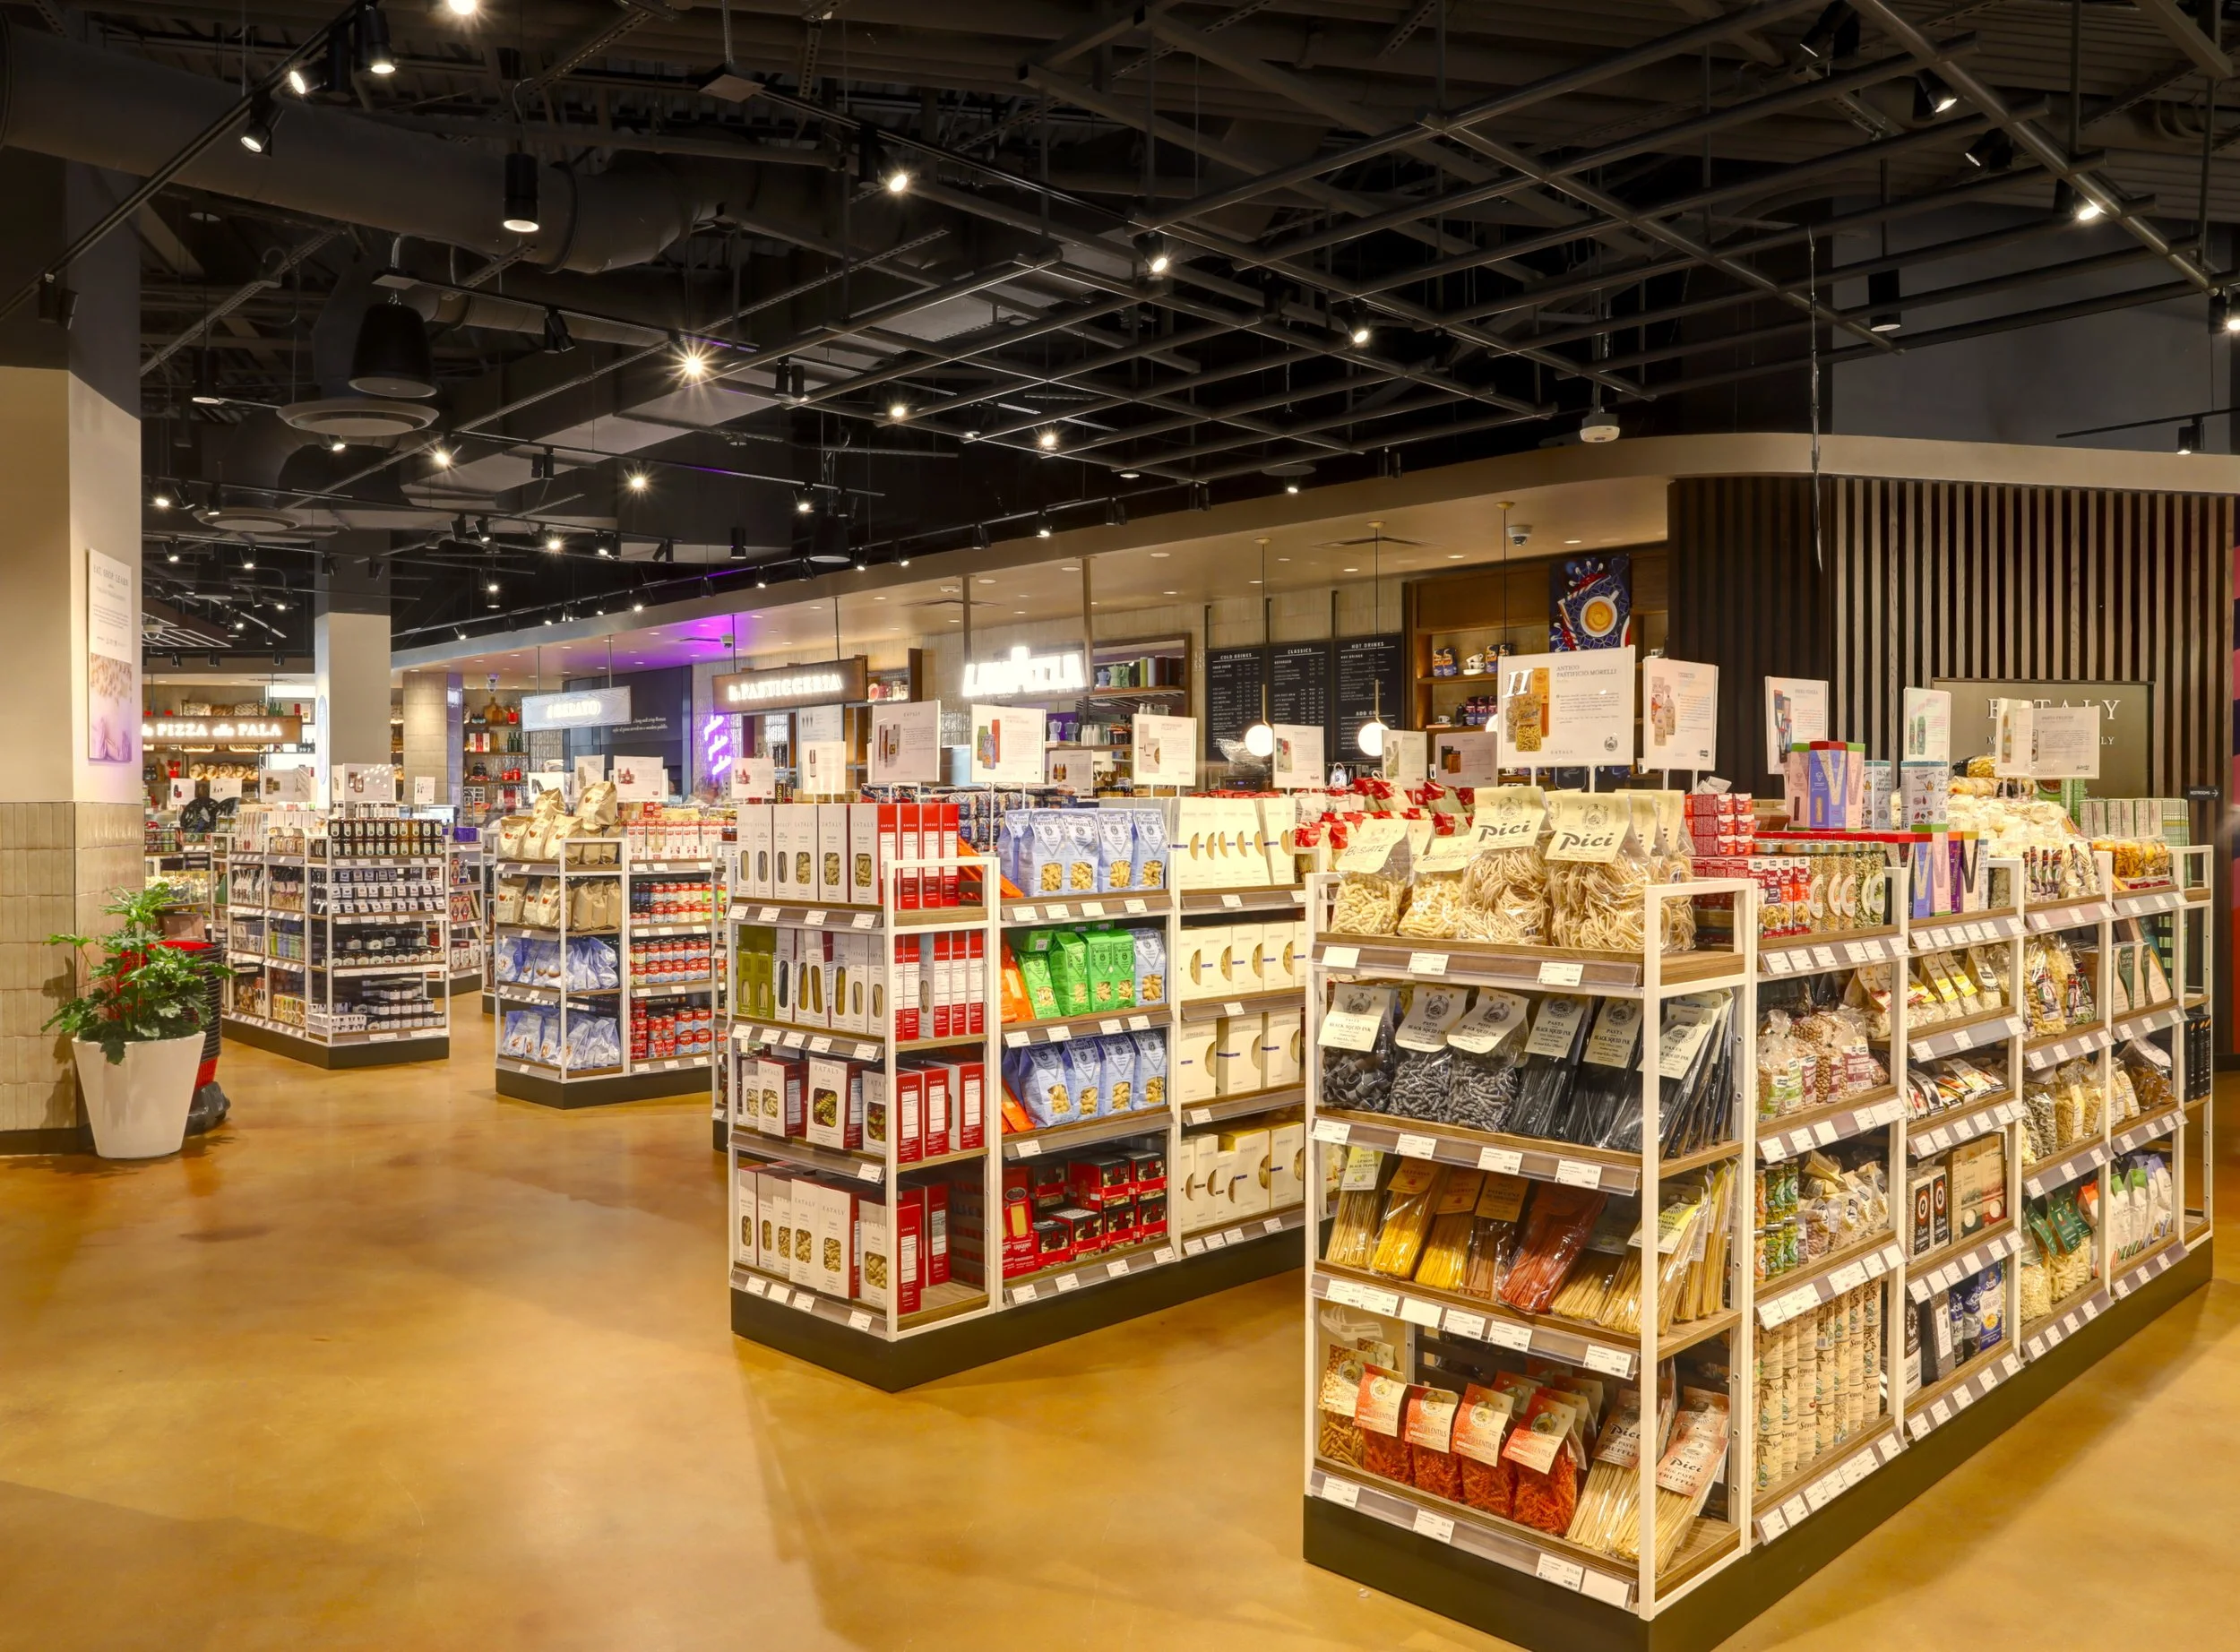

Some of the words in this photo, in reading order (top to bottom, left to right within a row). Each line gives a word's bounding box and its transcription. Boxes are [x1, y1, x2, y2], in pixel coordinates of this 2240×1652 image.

[740, 674, 842, 700] PASTICCERIA
[157, 723, 208, 736] PIZZA
[237, 723, 282, 736] PALA
[1478, 820, 1530, 842] Pici
[1559, 832, 1615, 851] Pici
[1608, 1037, 1622, 1045] SQUID
[814, 1064, 840, 1075] EATALY
[823, 1205, 845, 1216] EATALY
[1377, 1411, 1395, 1422] LENTILS
[1427, 1427, 1447, 1437] LENTILS
[1477, 1437, 1495, 1450] LENTILS
[1618, 1441, 1636, 1450] PASTA
[1670, 1456, 1702, 1473] Pici
[1658, 1472, 1698, 1487] TRUFFLE
[1677, 1471, 1695, 1480] PASTA
